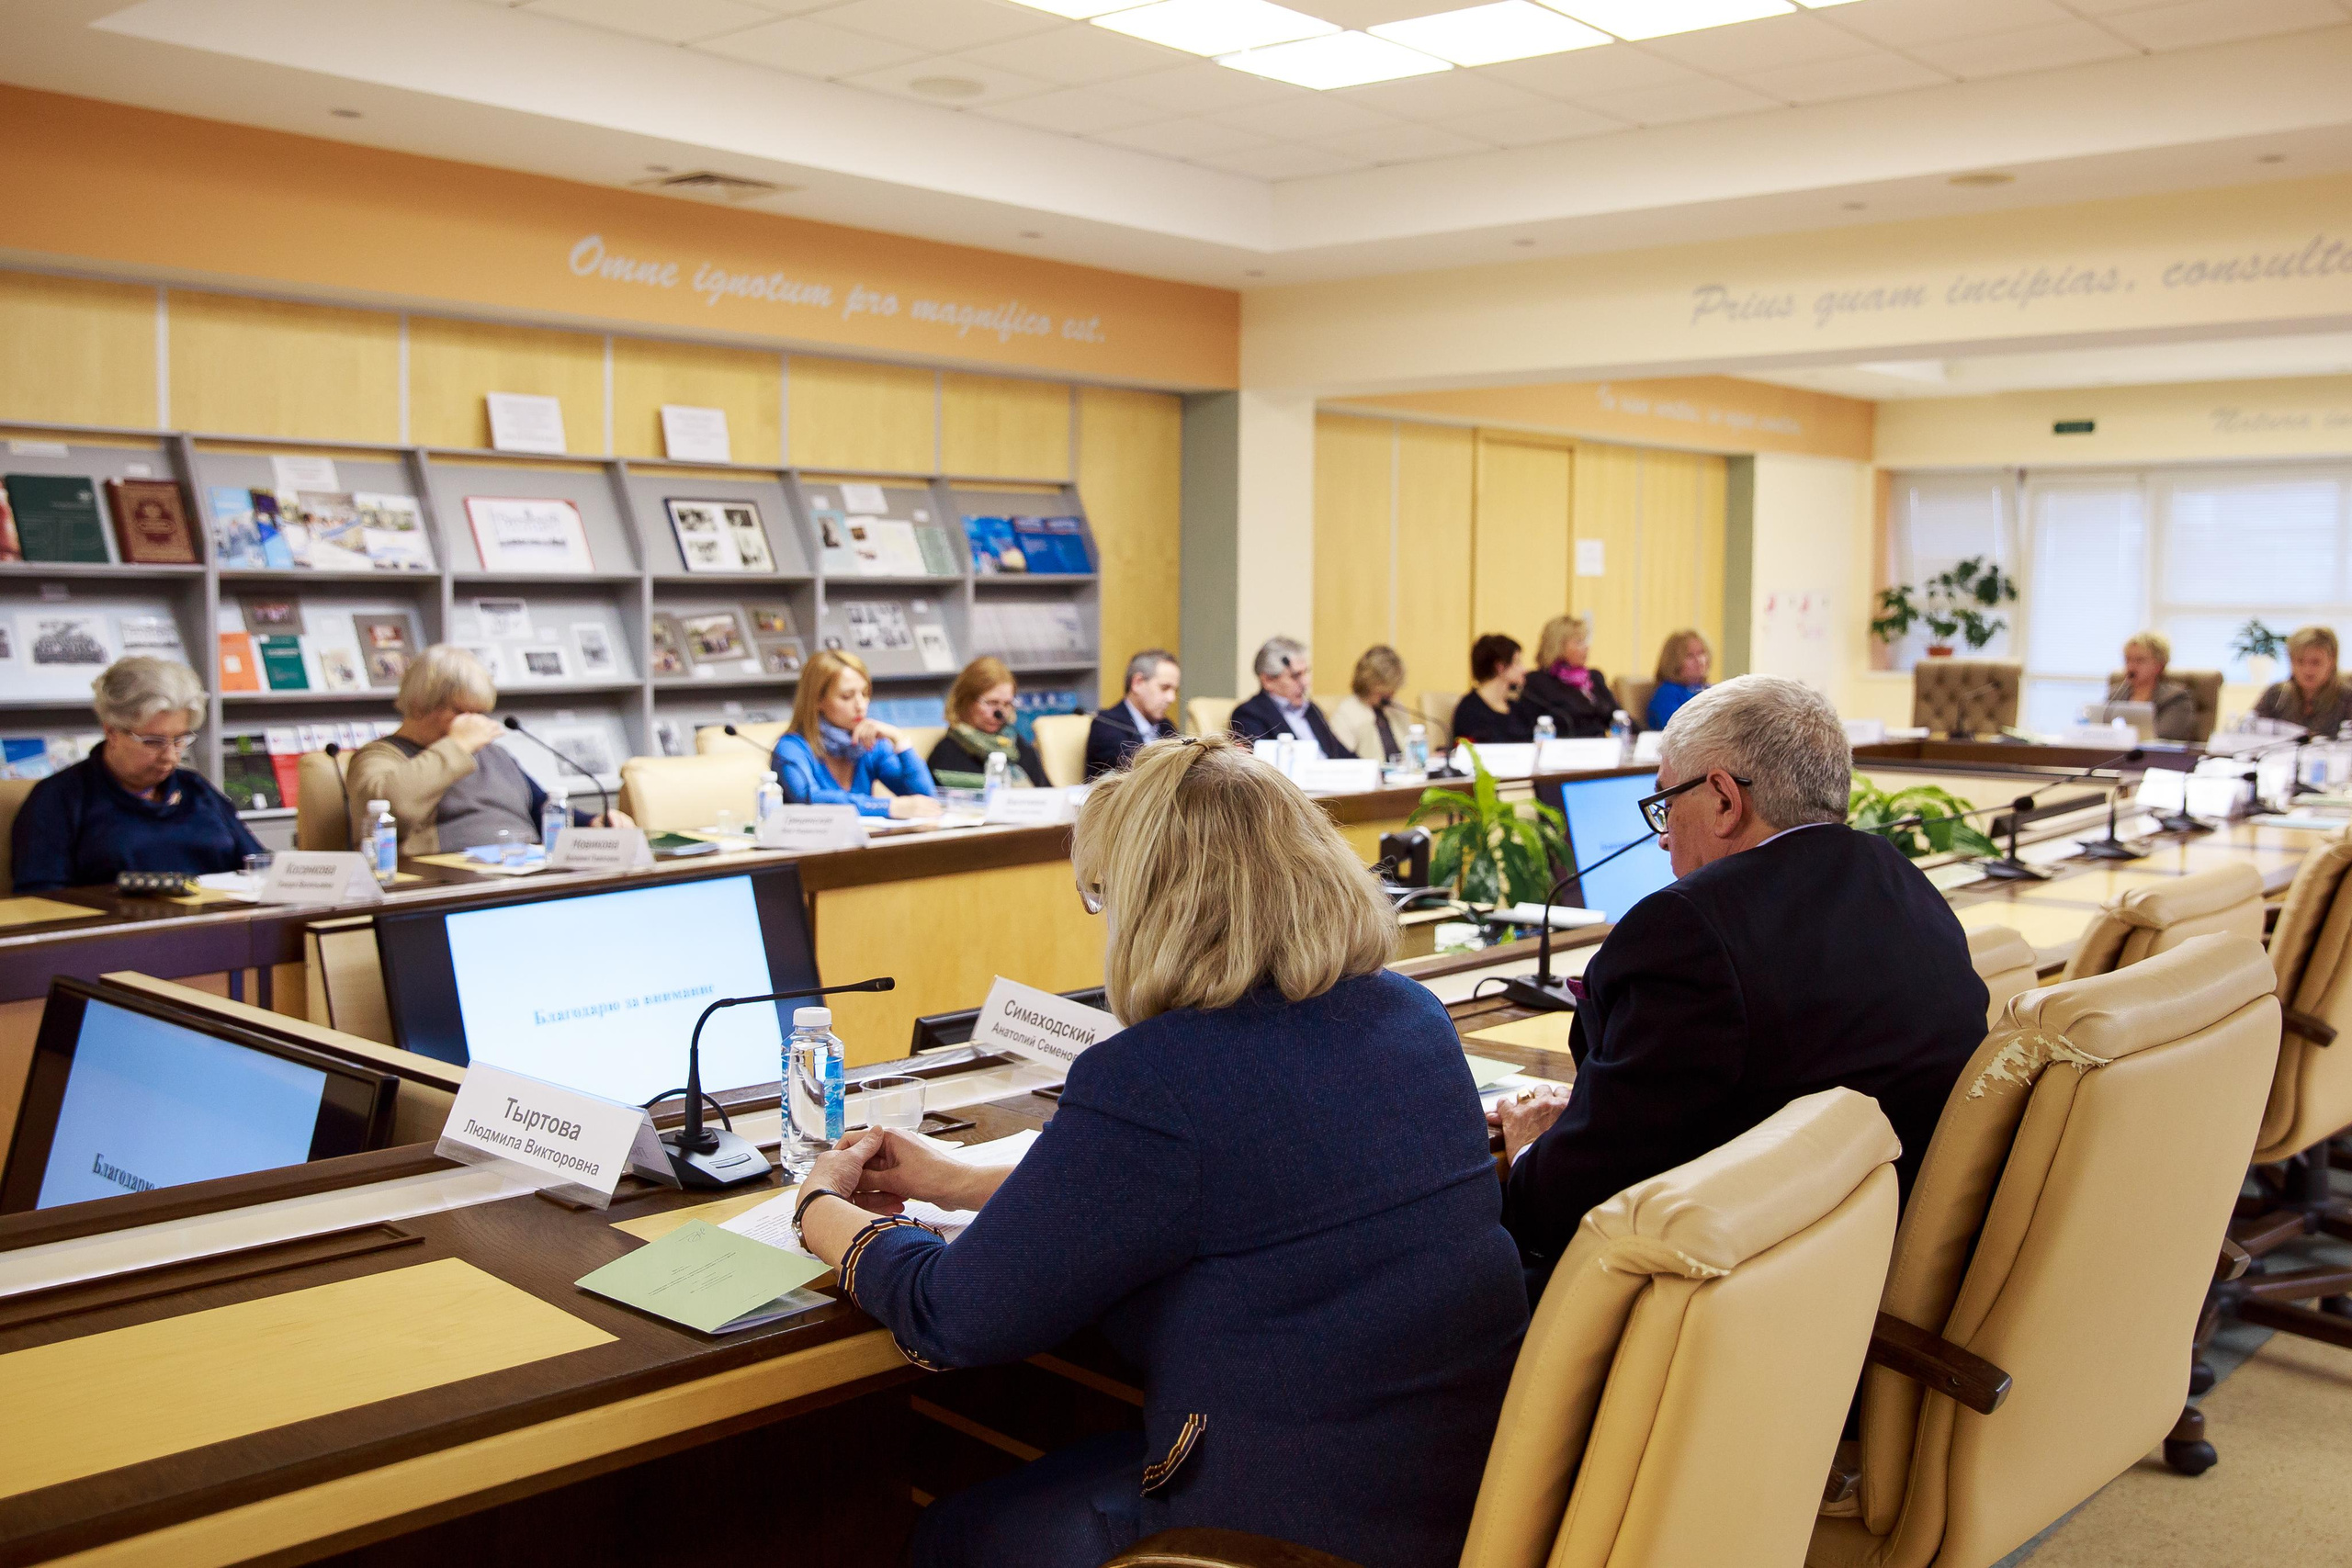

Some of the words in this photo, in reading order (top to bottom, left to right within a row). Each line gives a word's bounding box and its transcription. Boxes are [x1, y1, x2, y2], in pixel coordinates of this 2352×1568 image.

[569, 233, 679, 288] Omne
[691, 261, 833, 308] ignotum
[841, 282, 899, 321] pro
[910, 299, 1052, 344] magnifico
[1690, 282, 1797, 326] Prius
[533, 998, 620, 1026] Благодарю
[626, 997, 639, 1010] за
[644, 984, 715, 1006] внимание
[1004, 999, 1096, 1046] Симаходский
[991, 1021, 1036, 1048] Анатолий
[503, 1097, 582, 1141] Тыртова
[463, 1119, 523, 1150] Людмила
[524, 1137, 600, 1177] Викторовна
[92, 1152, 155, 1192] Благодарю
